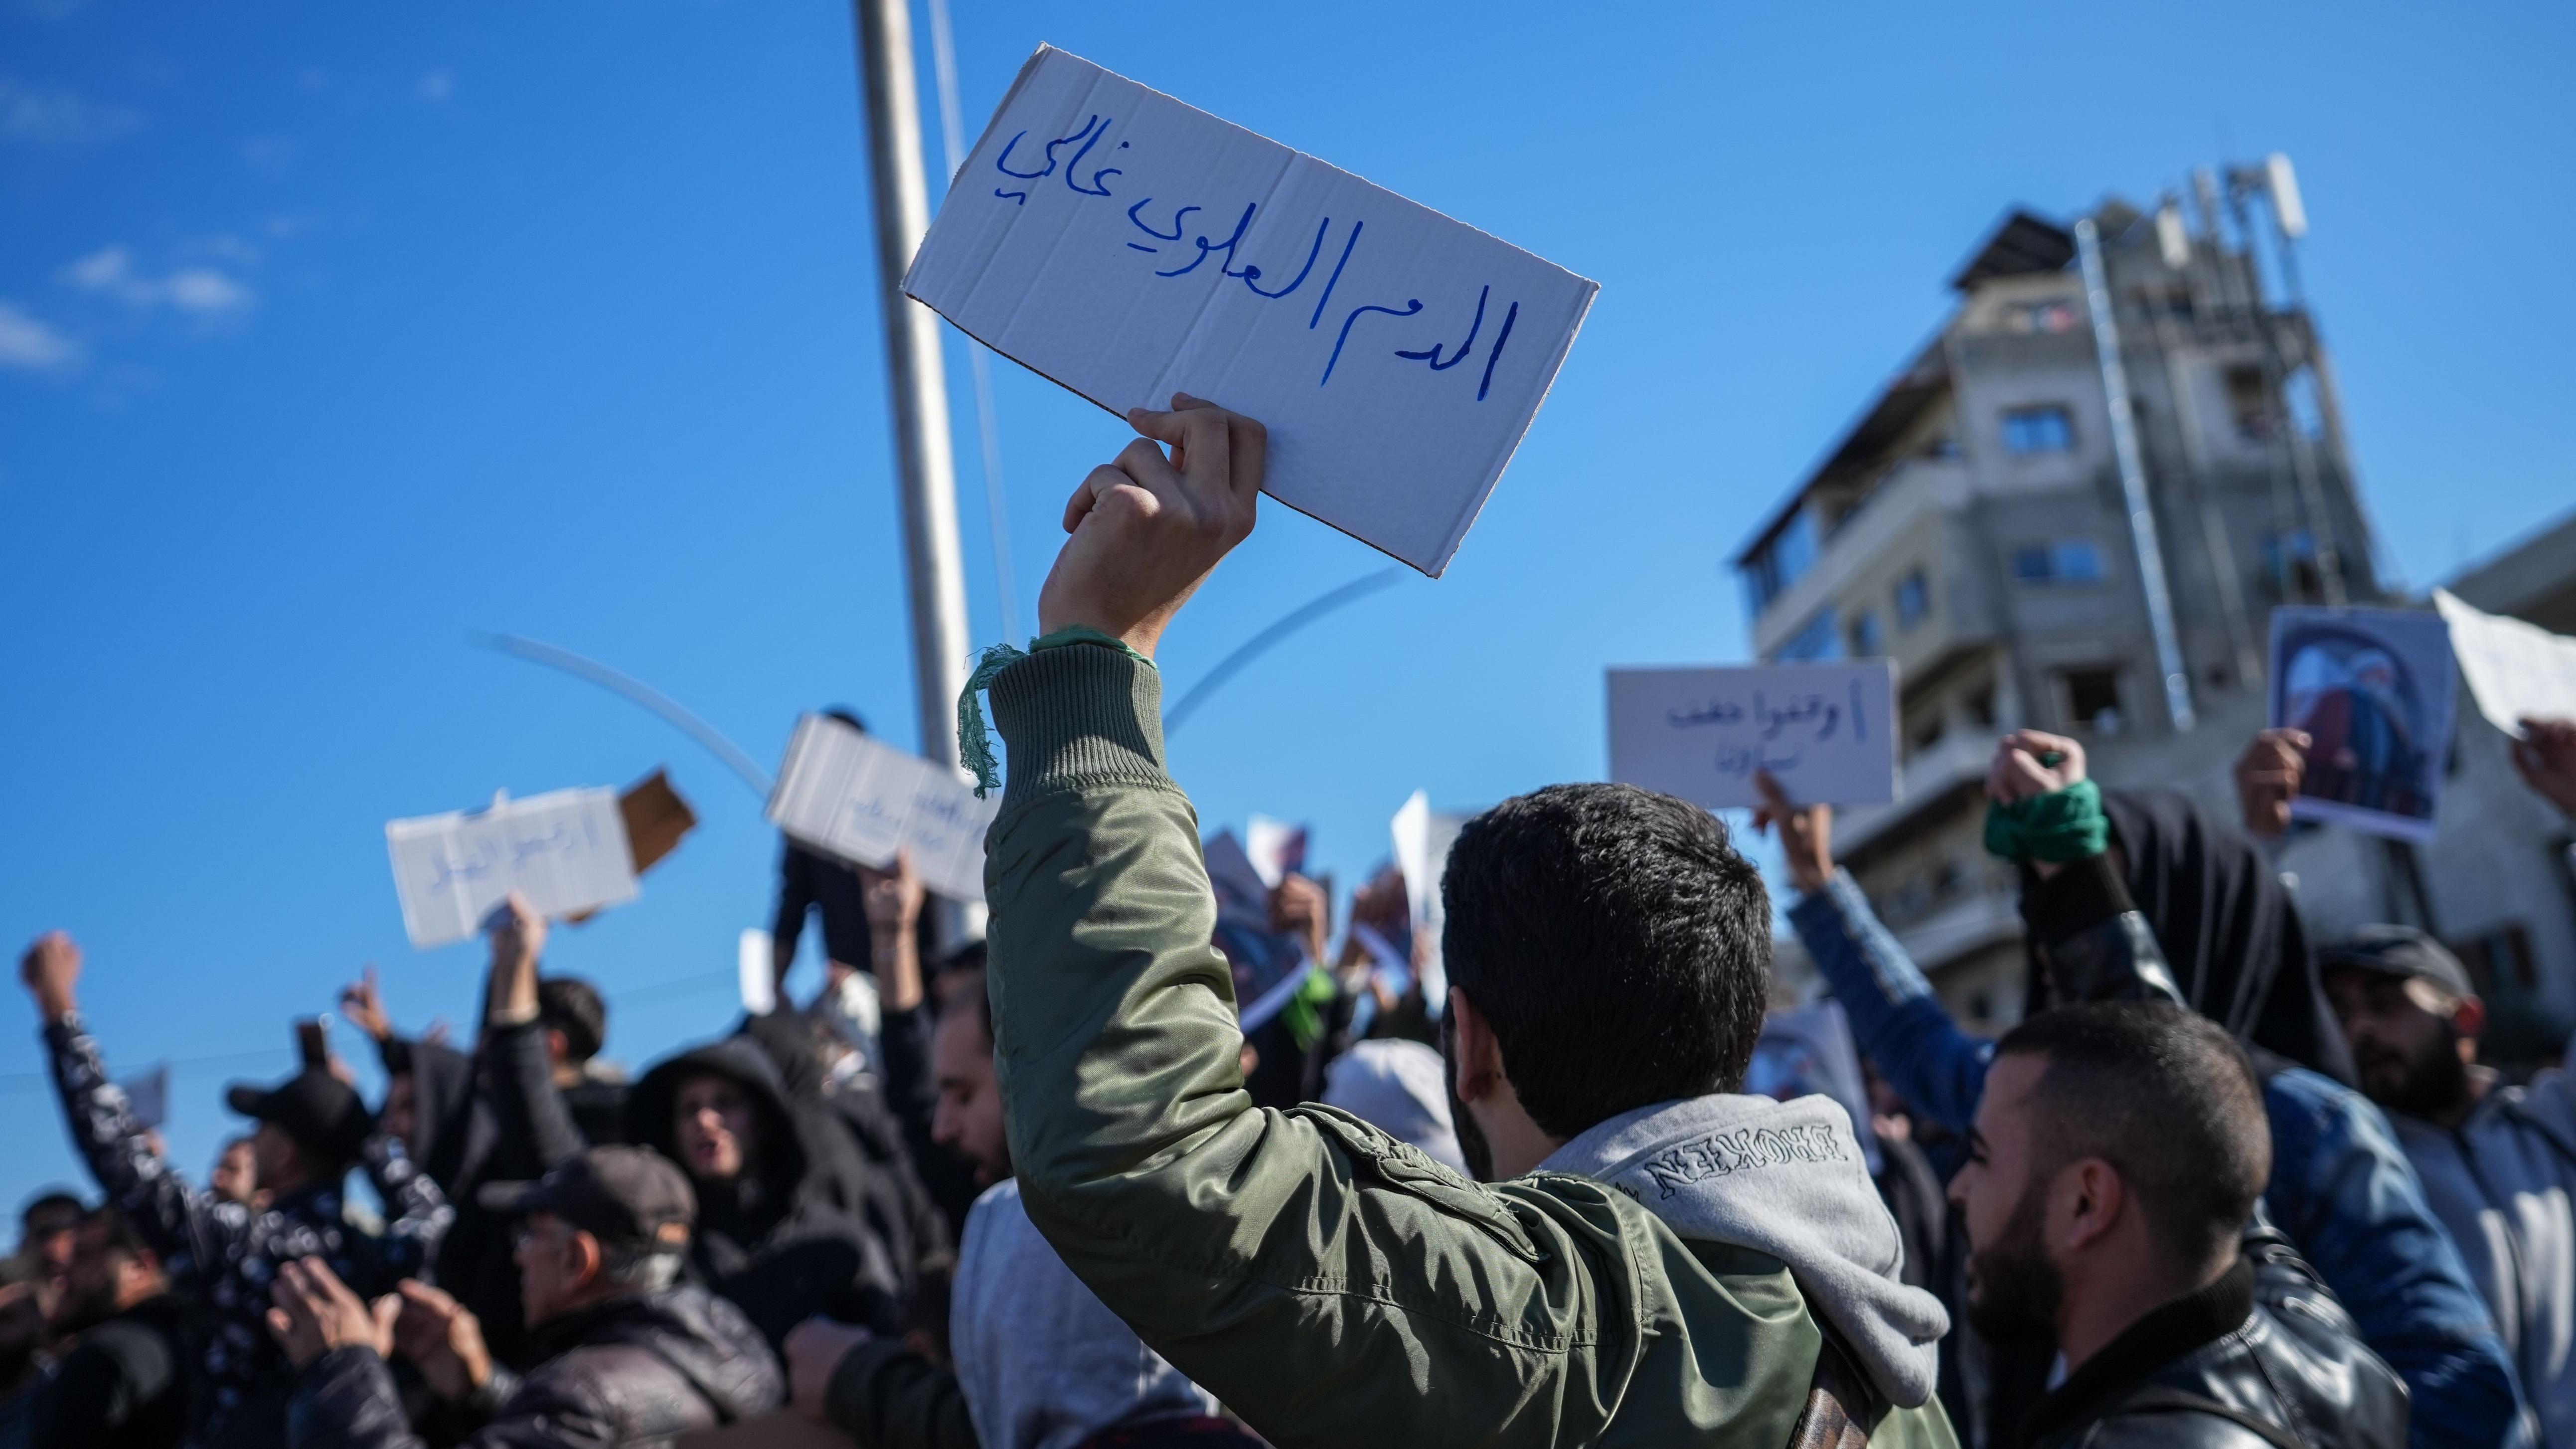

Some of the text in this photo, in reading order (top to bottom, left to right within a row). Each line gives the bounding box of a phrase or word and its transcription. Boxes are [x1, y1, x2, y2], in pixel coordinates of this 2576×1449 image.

[994, 114, 1519, 402] الدم العلوي غالي
[1644, 1124, 1848, 1201] BROKEN
